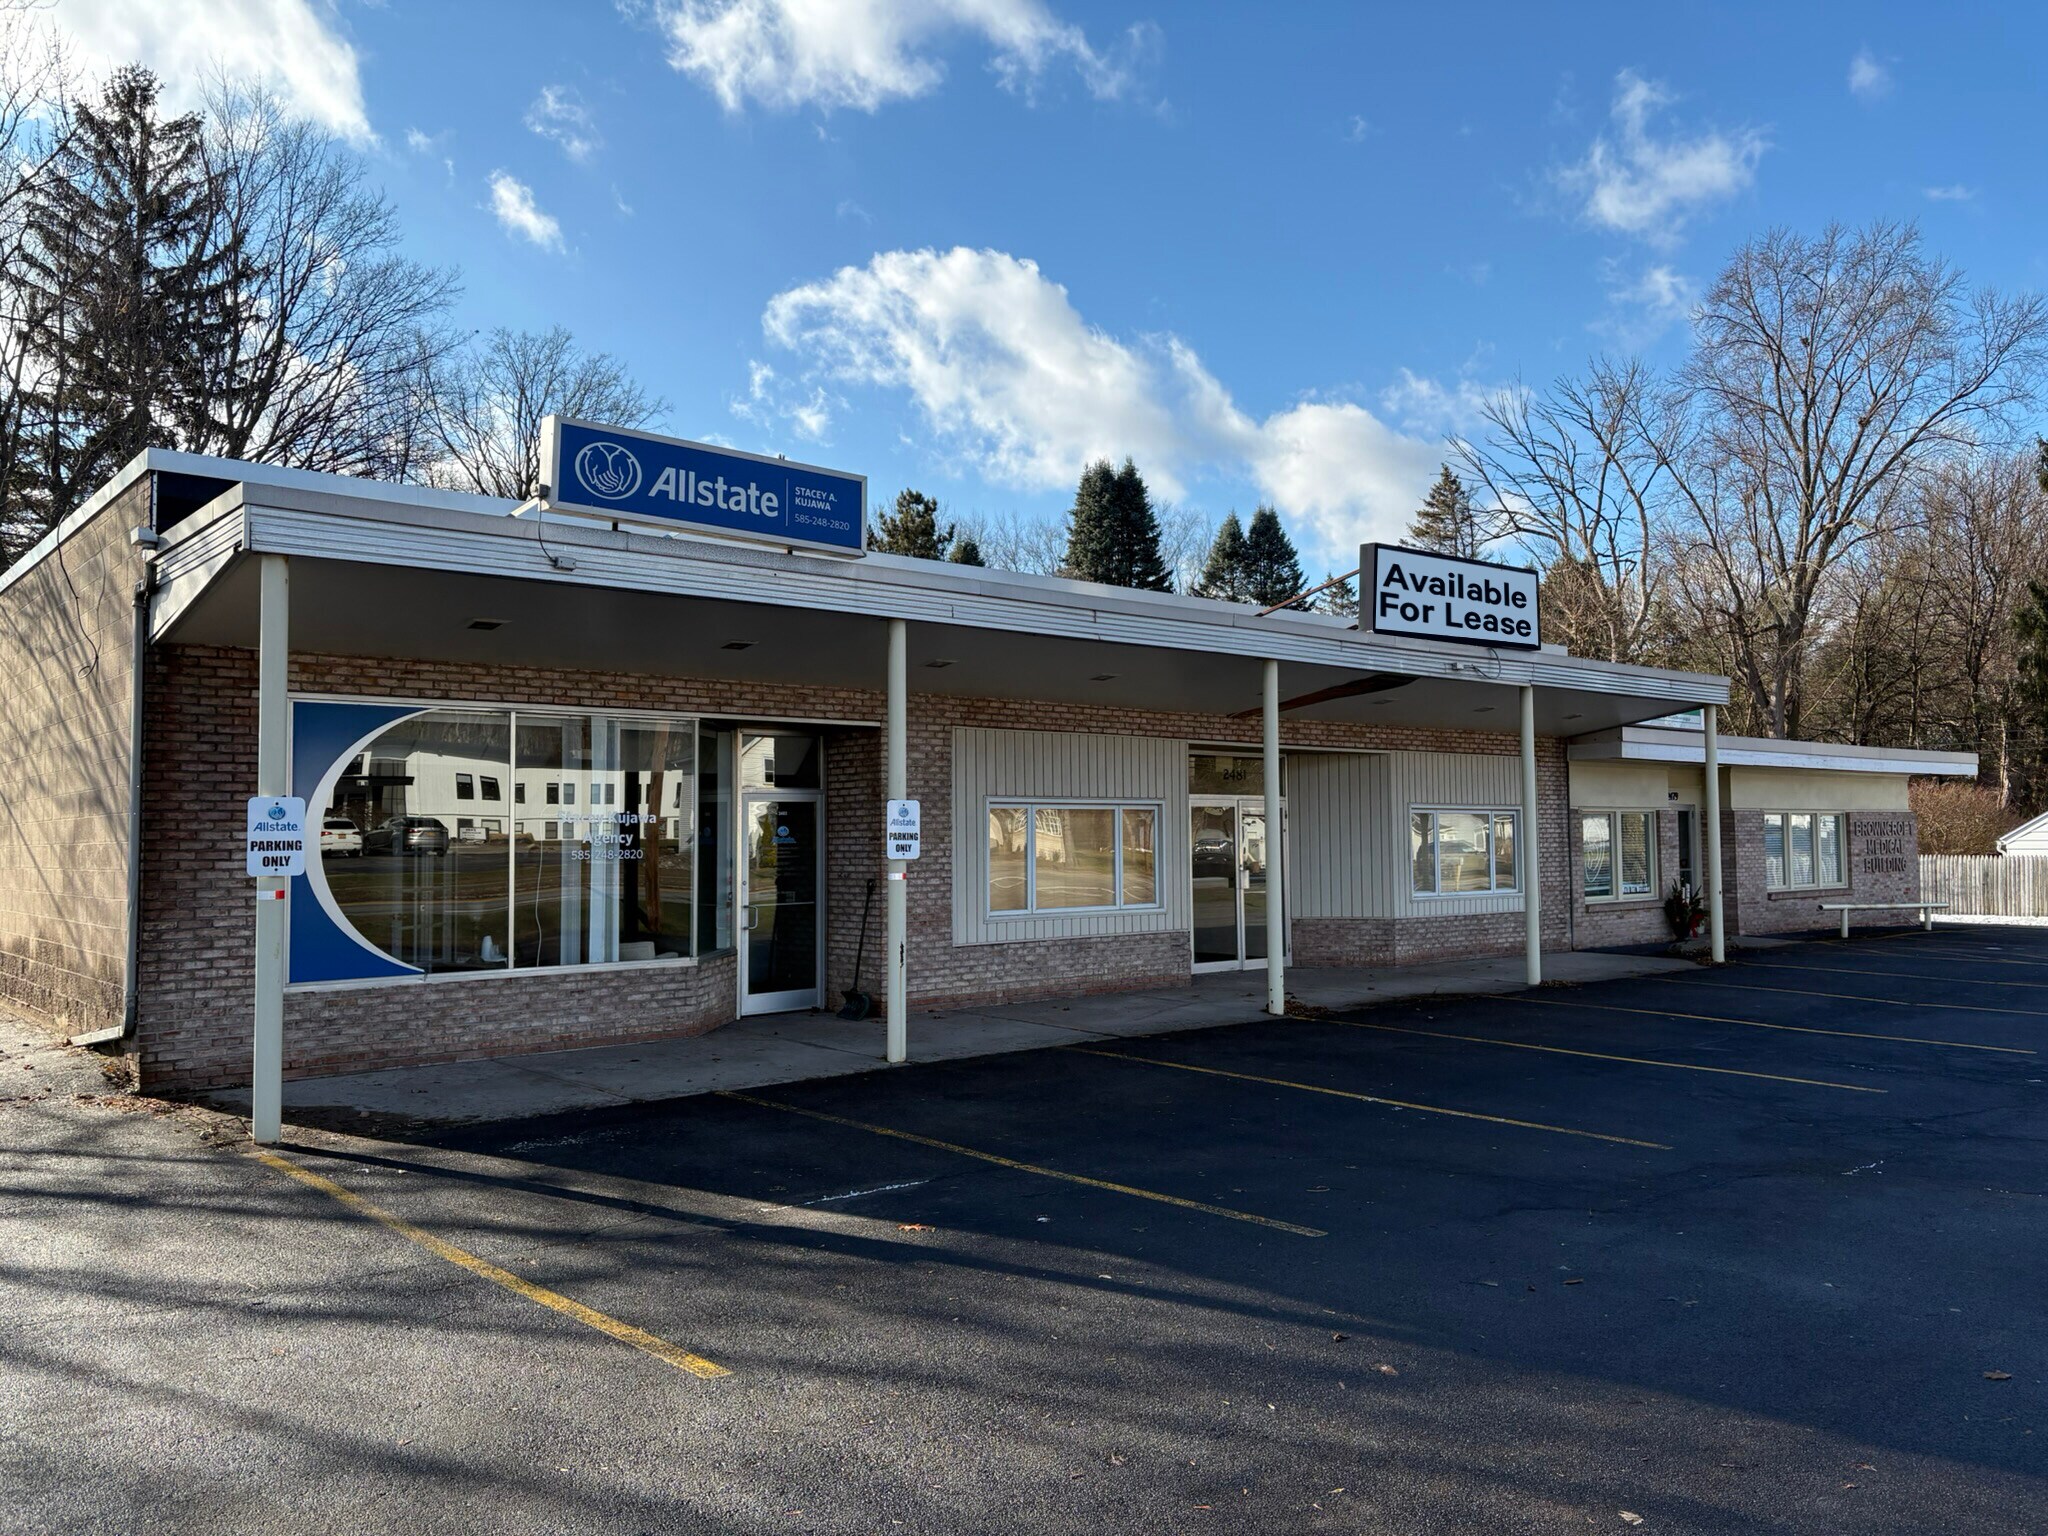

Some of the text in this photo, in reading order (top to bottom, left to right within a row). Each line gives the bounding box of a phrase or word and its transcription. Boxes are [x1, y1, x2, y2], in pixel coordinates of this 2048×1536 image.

[648, 466, 779, 518] Allstate
[795, 486, 838, 502] STACEY A.
[795, 497, 831, 511] KUJAWA
[794, 513, 851, 531] 585-248-2820
[1383, 563, 1528, 609] Available
[1379, 591, 1532, 637] For Lease
[608, 811, 657, 826] Kujawa
[890, 818, 916, 826] Allstate
[253, 822, 299, 832] Allstate
[582, 832, 634, 846] Agency
[888, 832, 919, 841] PARKING
[250, 840, 302, 852] PARKING
[896, 844, 912, 853] ONLY
[1865, 838, 1903, 855] MEDICAL
[262, 855, 291, 867] ONLY
[571, 849, 644, 860] 585-248-2820
[1863, 856, 1907, 873] BUILDING
